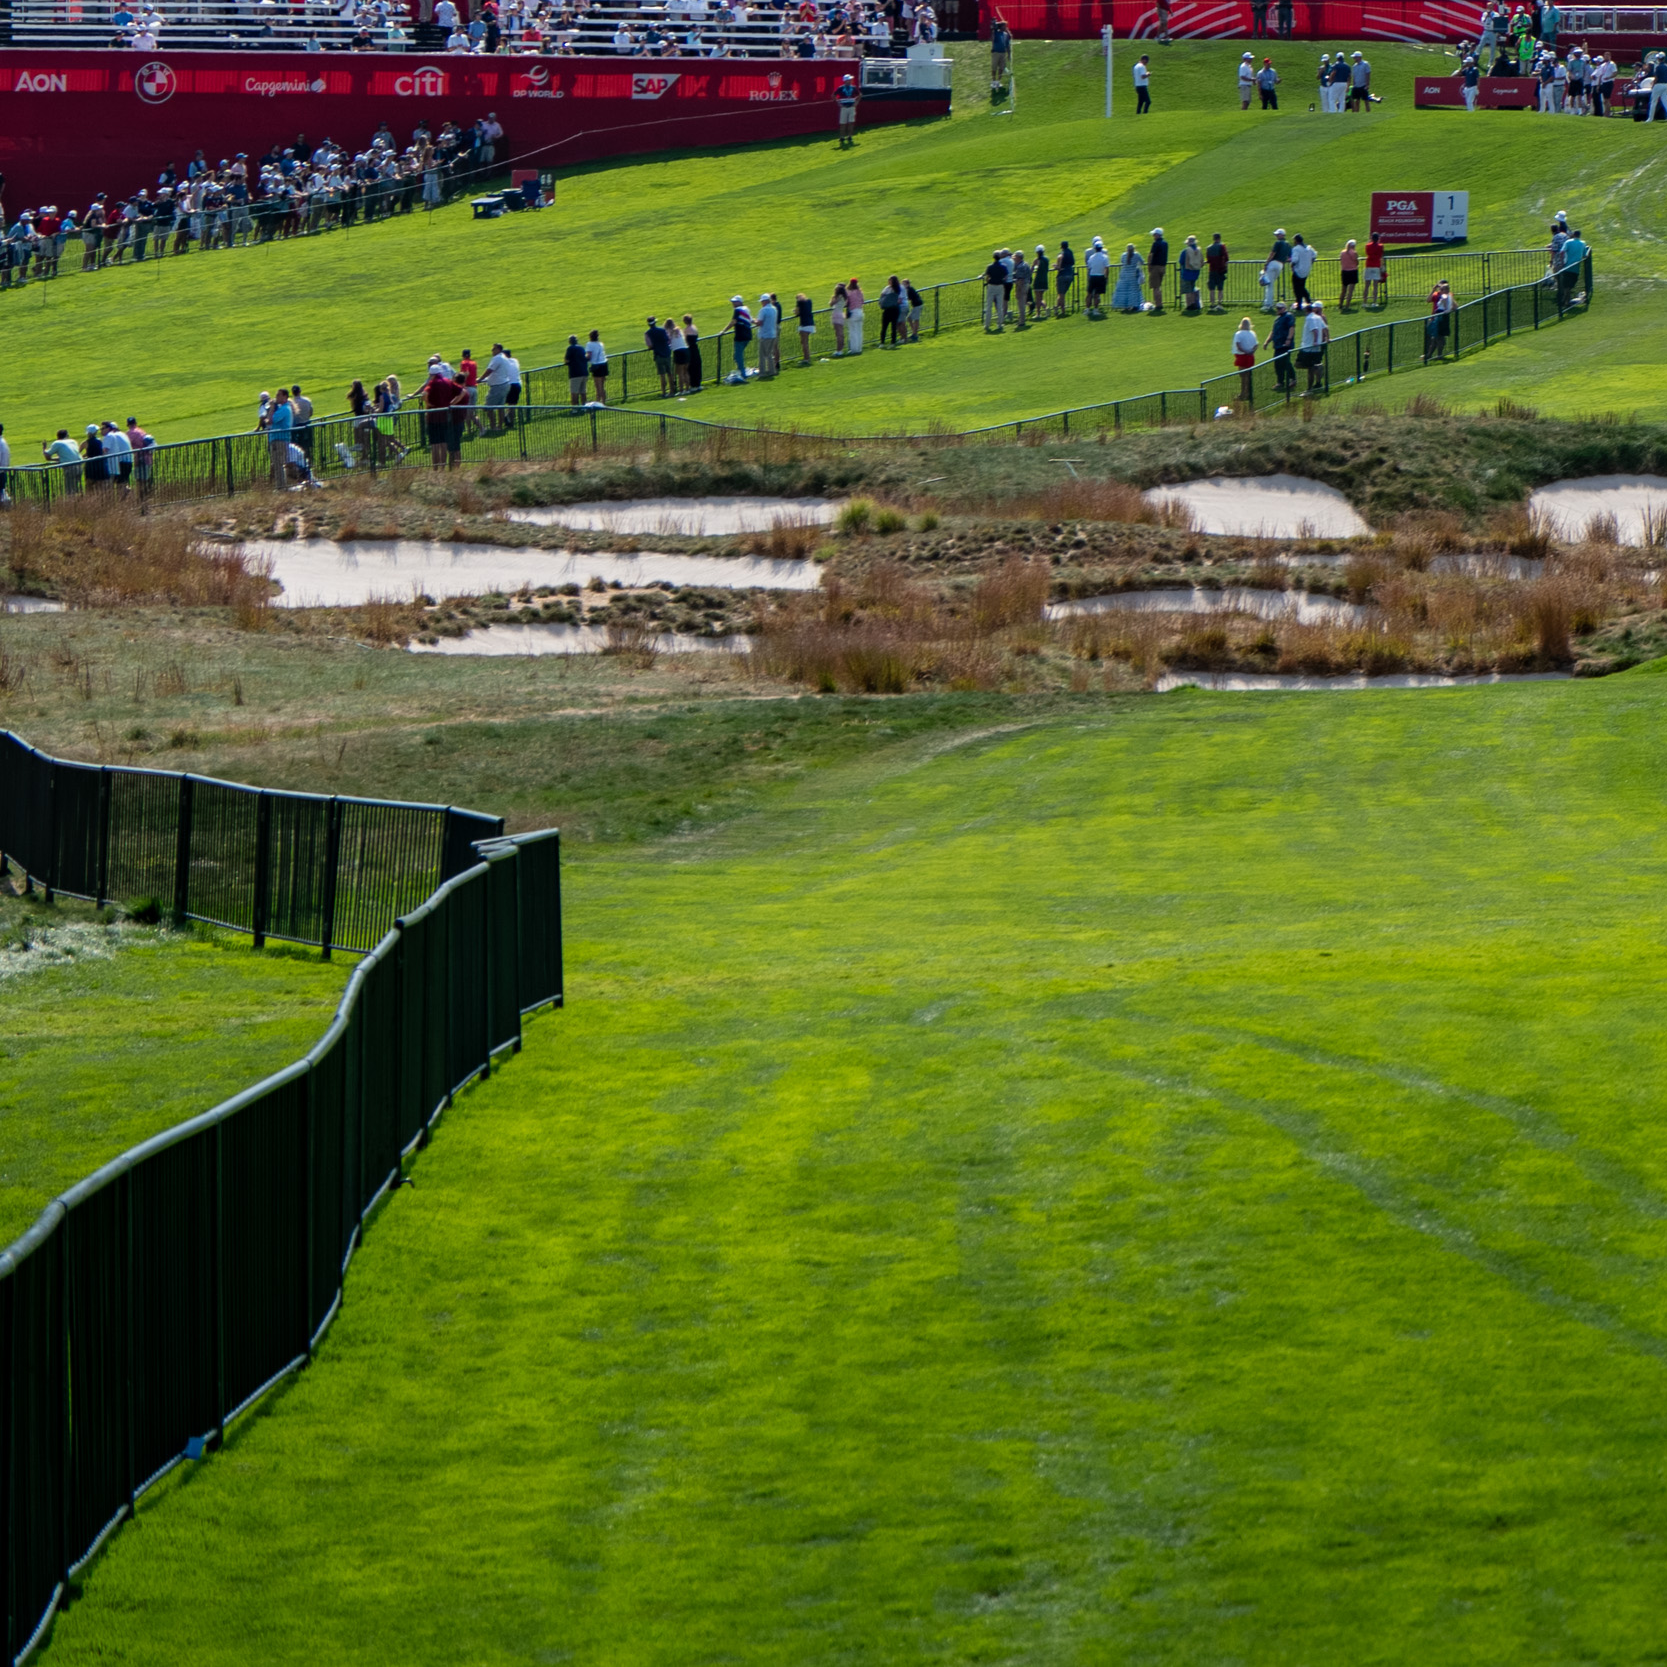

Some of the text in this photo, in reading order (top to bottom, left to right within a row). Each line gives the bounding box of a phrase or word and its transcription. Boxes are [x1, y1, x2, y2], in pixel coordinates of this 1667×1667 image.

[14, 72, 67, 92] AON
[245, 77, 311, 96] Capgemini
[394, 66, 444, 96] citi
[633, 77, 670, 96] SAP
[513, 90, 564, 98] DP WORLD
[749, 90, 799, 101] ROLEX
[1424, 86, 1440, 94] AON
[1386, 200, 1418, 210] PGA
[1448, 196, 1454, 210] 1
